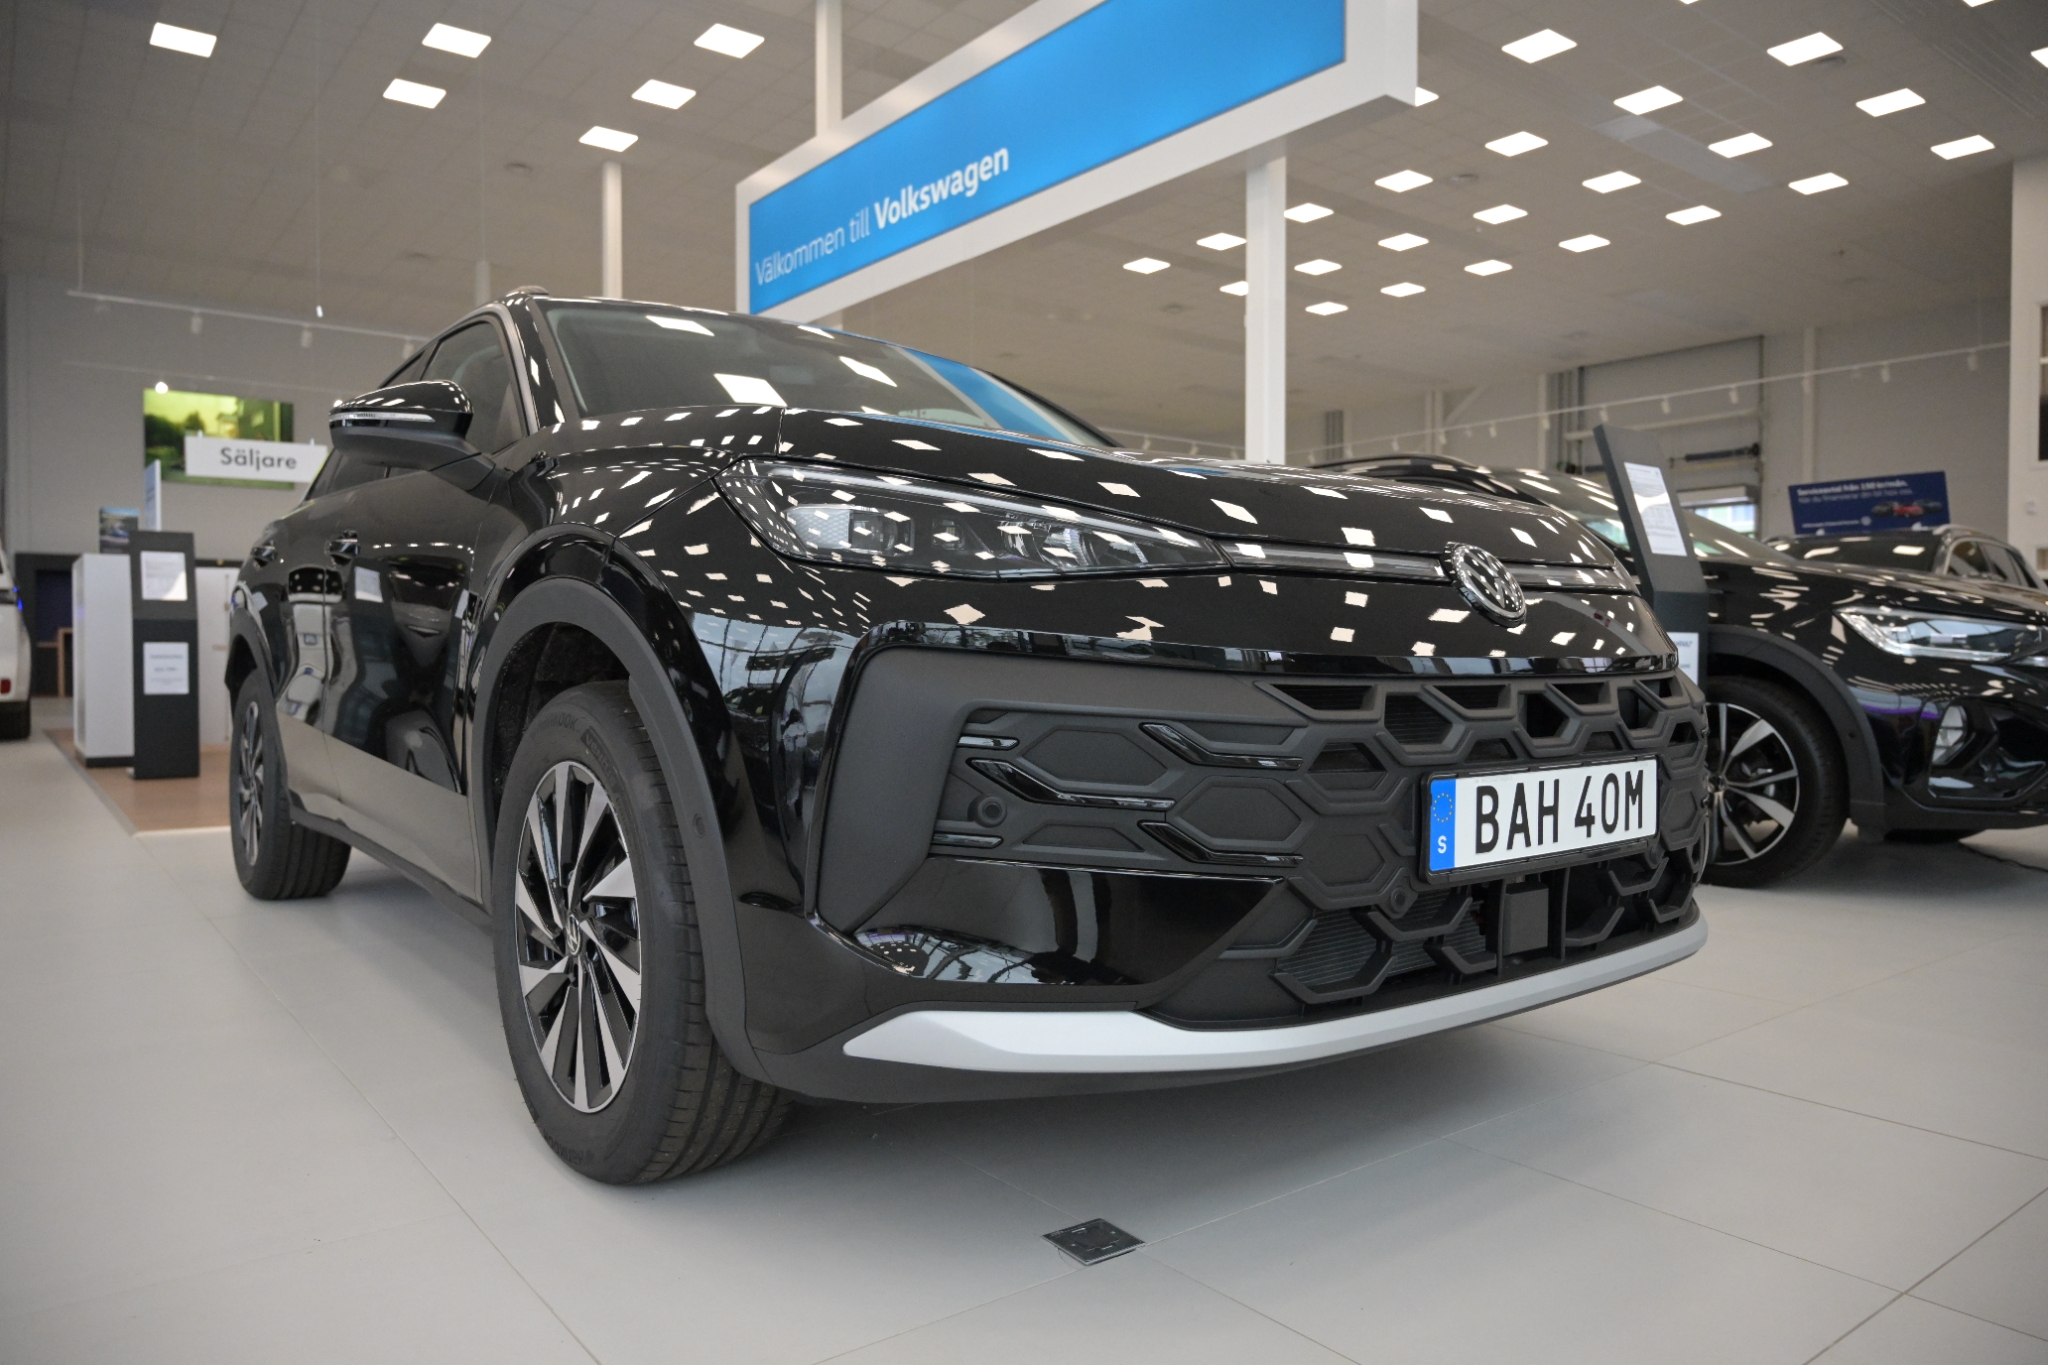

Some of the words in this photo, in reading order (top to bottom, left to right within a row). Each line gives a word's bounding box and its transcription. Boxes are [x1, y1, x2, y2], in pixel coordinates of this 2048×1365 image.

[755, 227, 845, 286] Välkommen
[849, 206, 870, 244] till
[874, 147, 1009, 230] Volkswagen
[221, 447, 297, 472] Säljare
[1475, 778, 1560, 854] BAH
[1574, 769, 1644, 838] 40M
[1437, 835, 1448, 854] S
